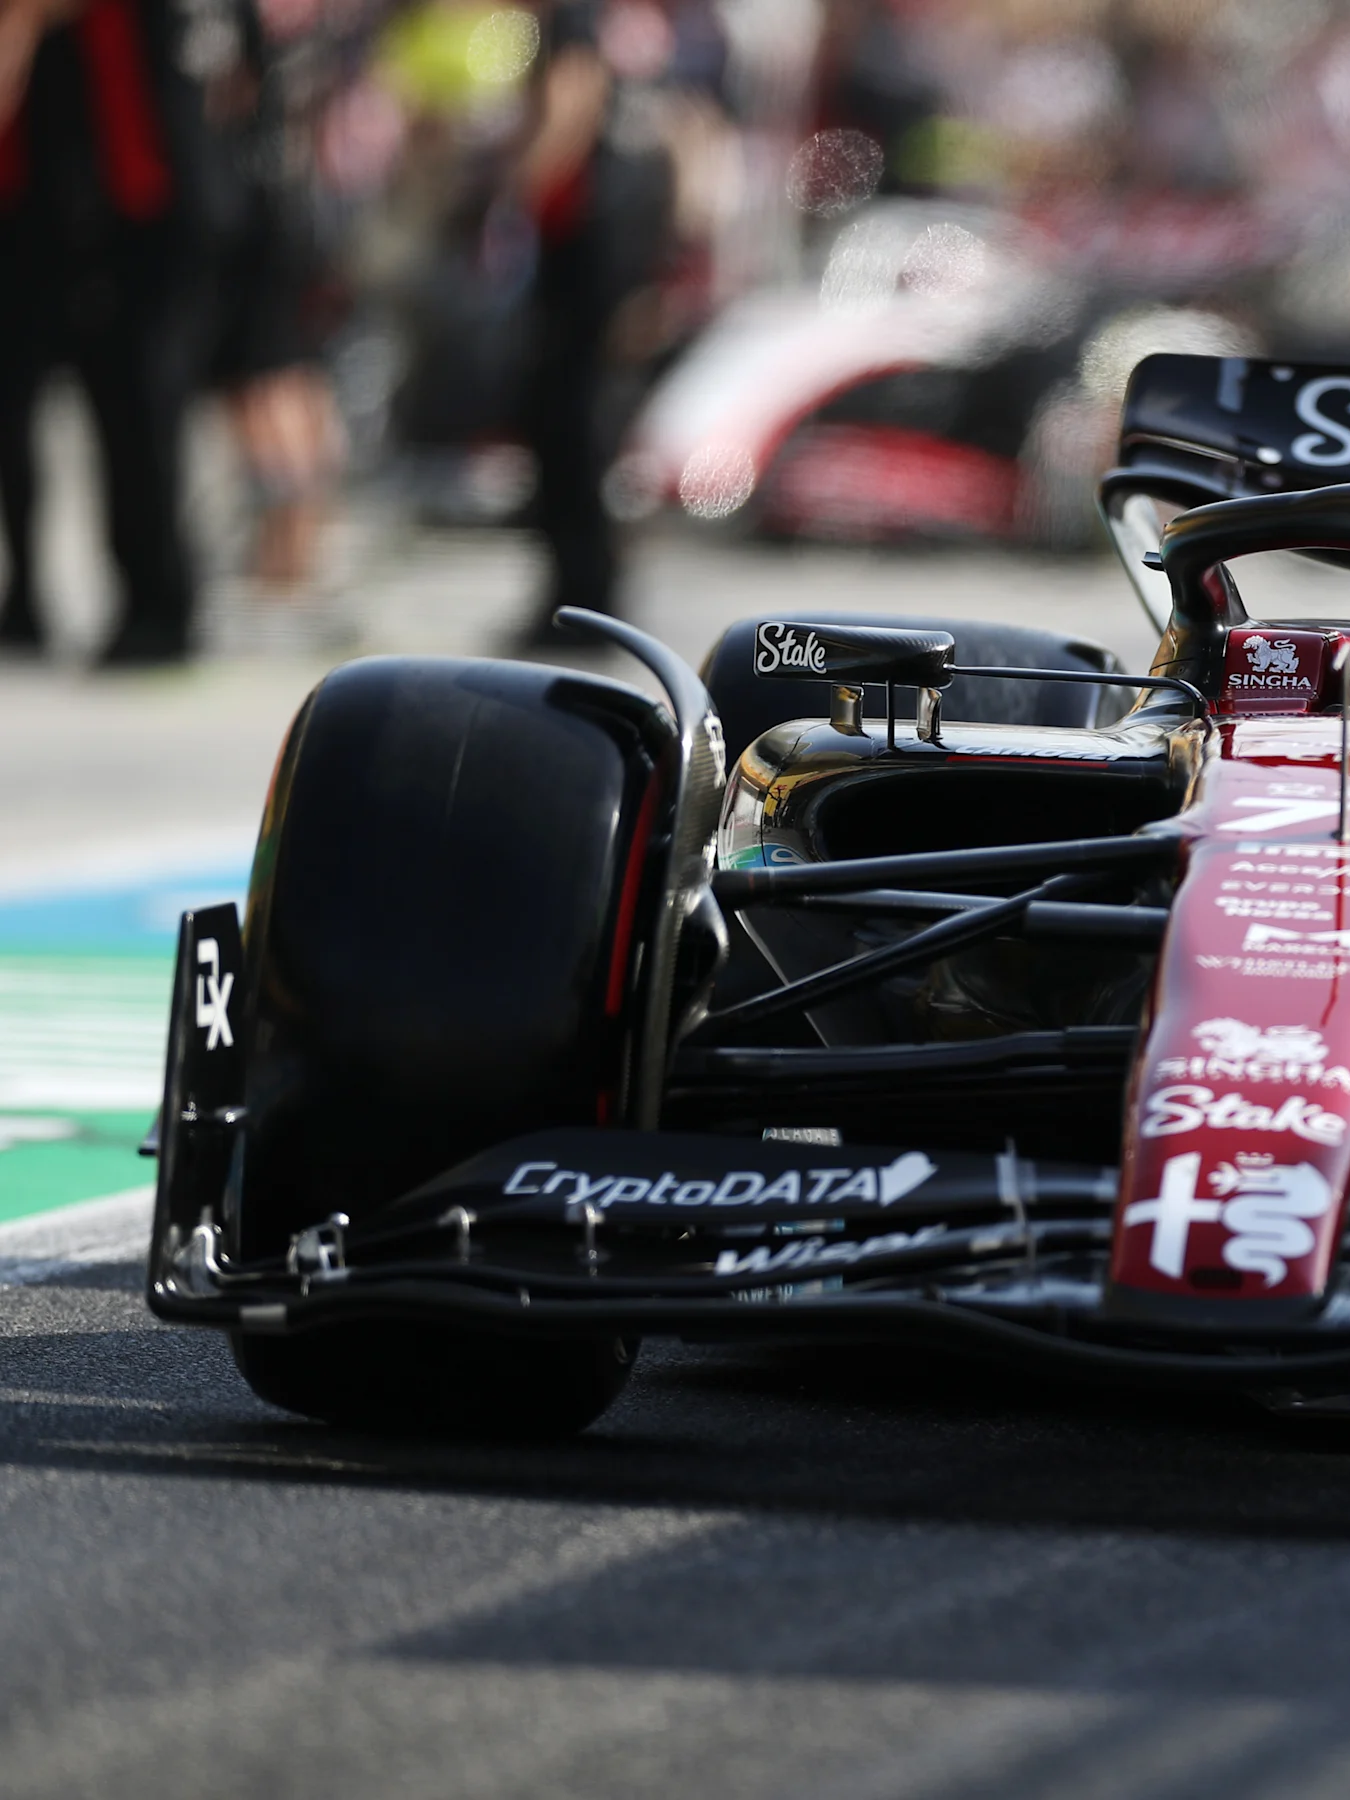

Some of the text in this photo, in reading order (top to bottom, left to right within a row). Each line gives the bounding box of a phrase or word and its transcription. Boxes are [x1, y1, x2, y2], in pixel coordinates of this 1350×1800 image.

[757, 622, 828, 674] Stake
[1228, 673, 1312, 687] SINGHA
[1141, 1084, 1348, 1147] Stake
[504, 1161, 879, 1207] CryptoDATA
